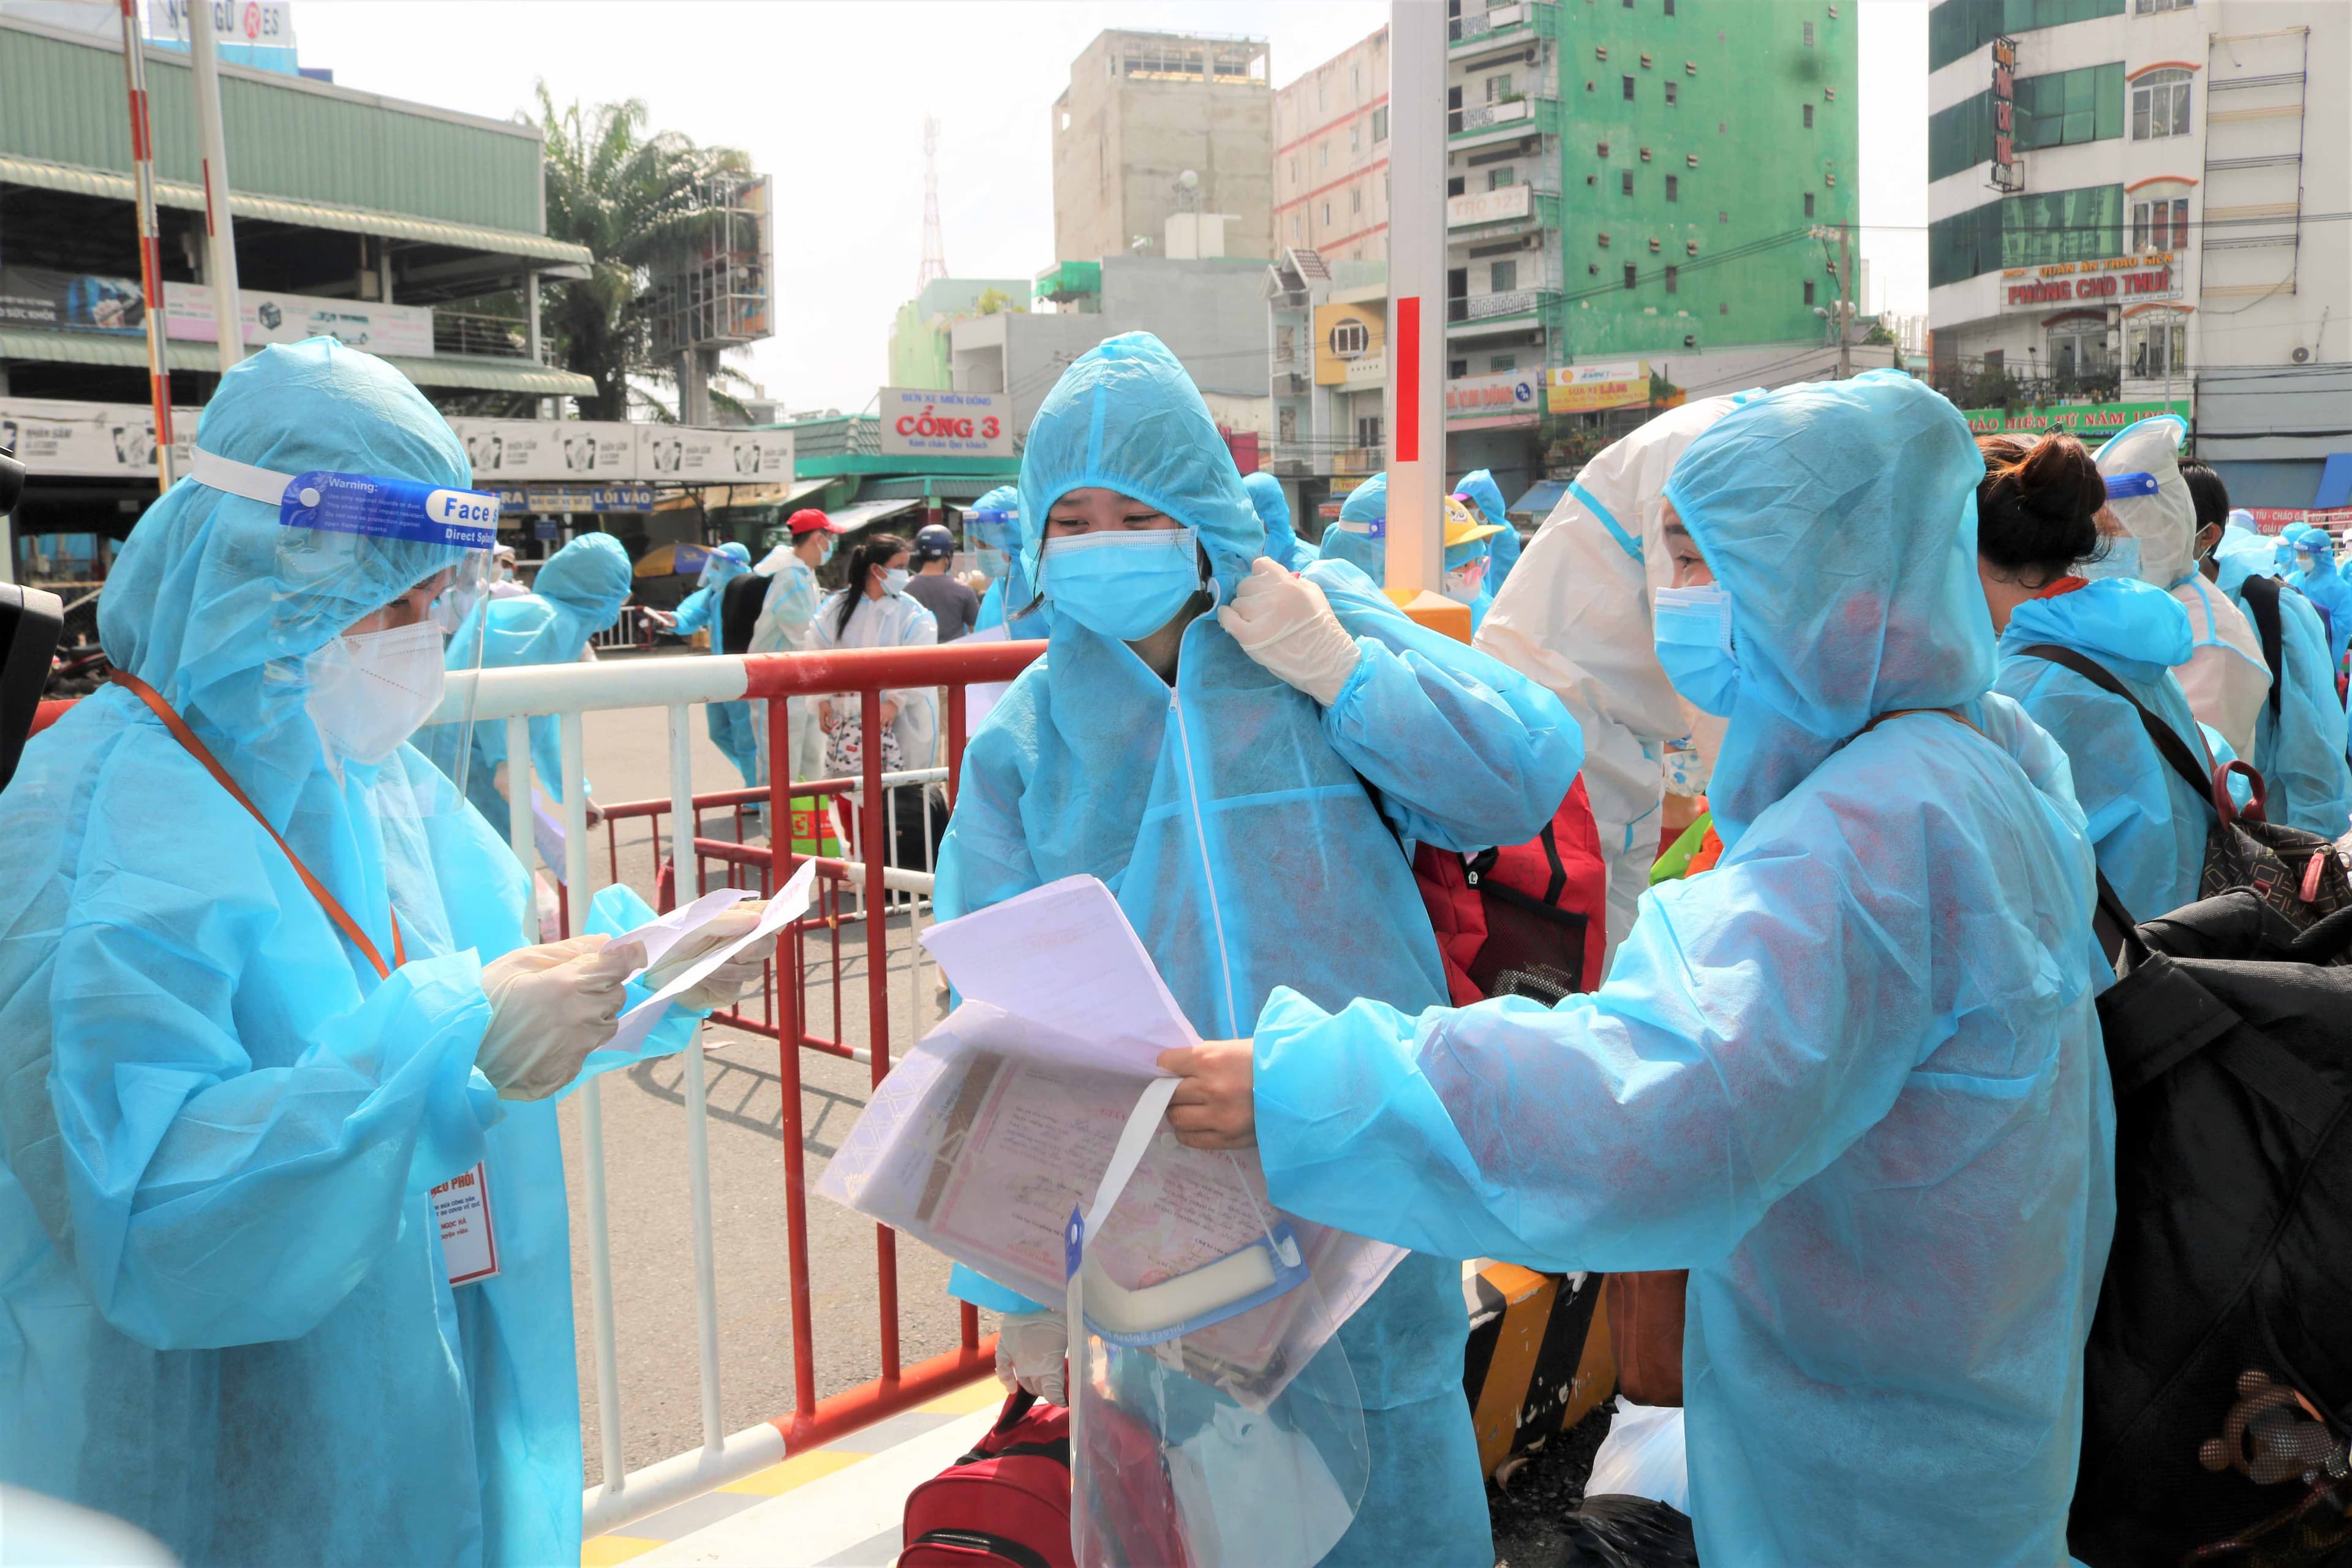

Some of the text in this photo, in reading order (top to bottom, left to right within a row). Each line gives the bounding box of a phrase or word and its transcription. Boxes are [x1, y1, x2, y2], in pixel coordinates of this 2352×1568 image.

[2008, 278, 2071, 305] PHÒNG
[2076, 276, 2117, 298] CHO
[1600, 382, 1627, 394] LÂM
[895, 404, 1001, 439] CỔNG 3
[2005, 411, 2048, 430] HIỀN
[2084, 409, 2125, 425] NĂM
[329, 477, 378, 493] Warning:
[444, 497, 489, 522] Face
[368, 516, 398, 525] protection
[445, 528, 475, 542] Direct
